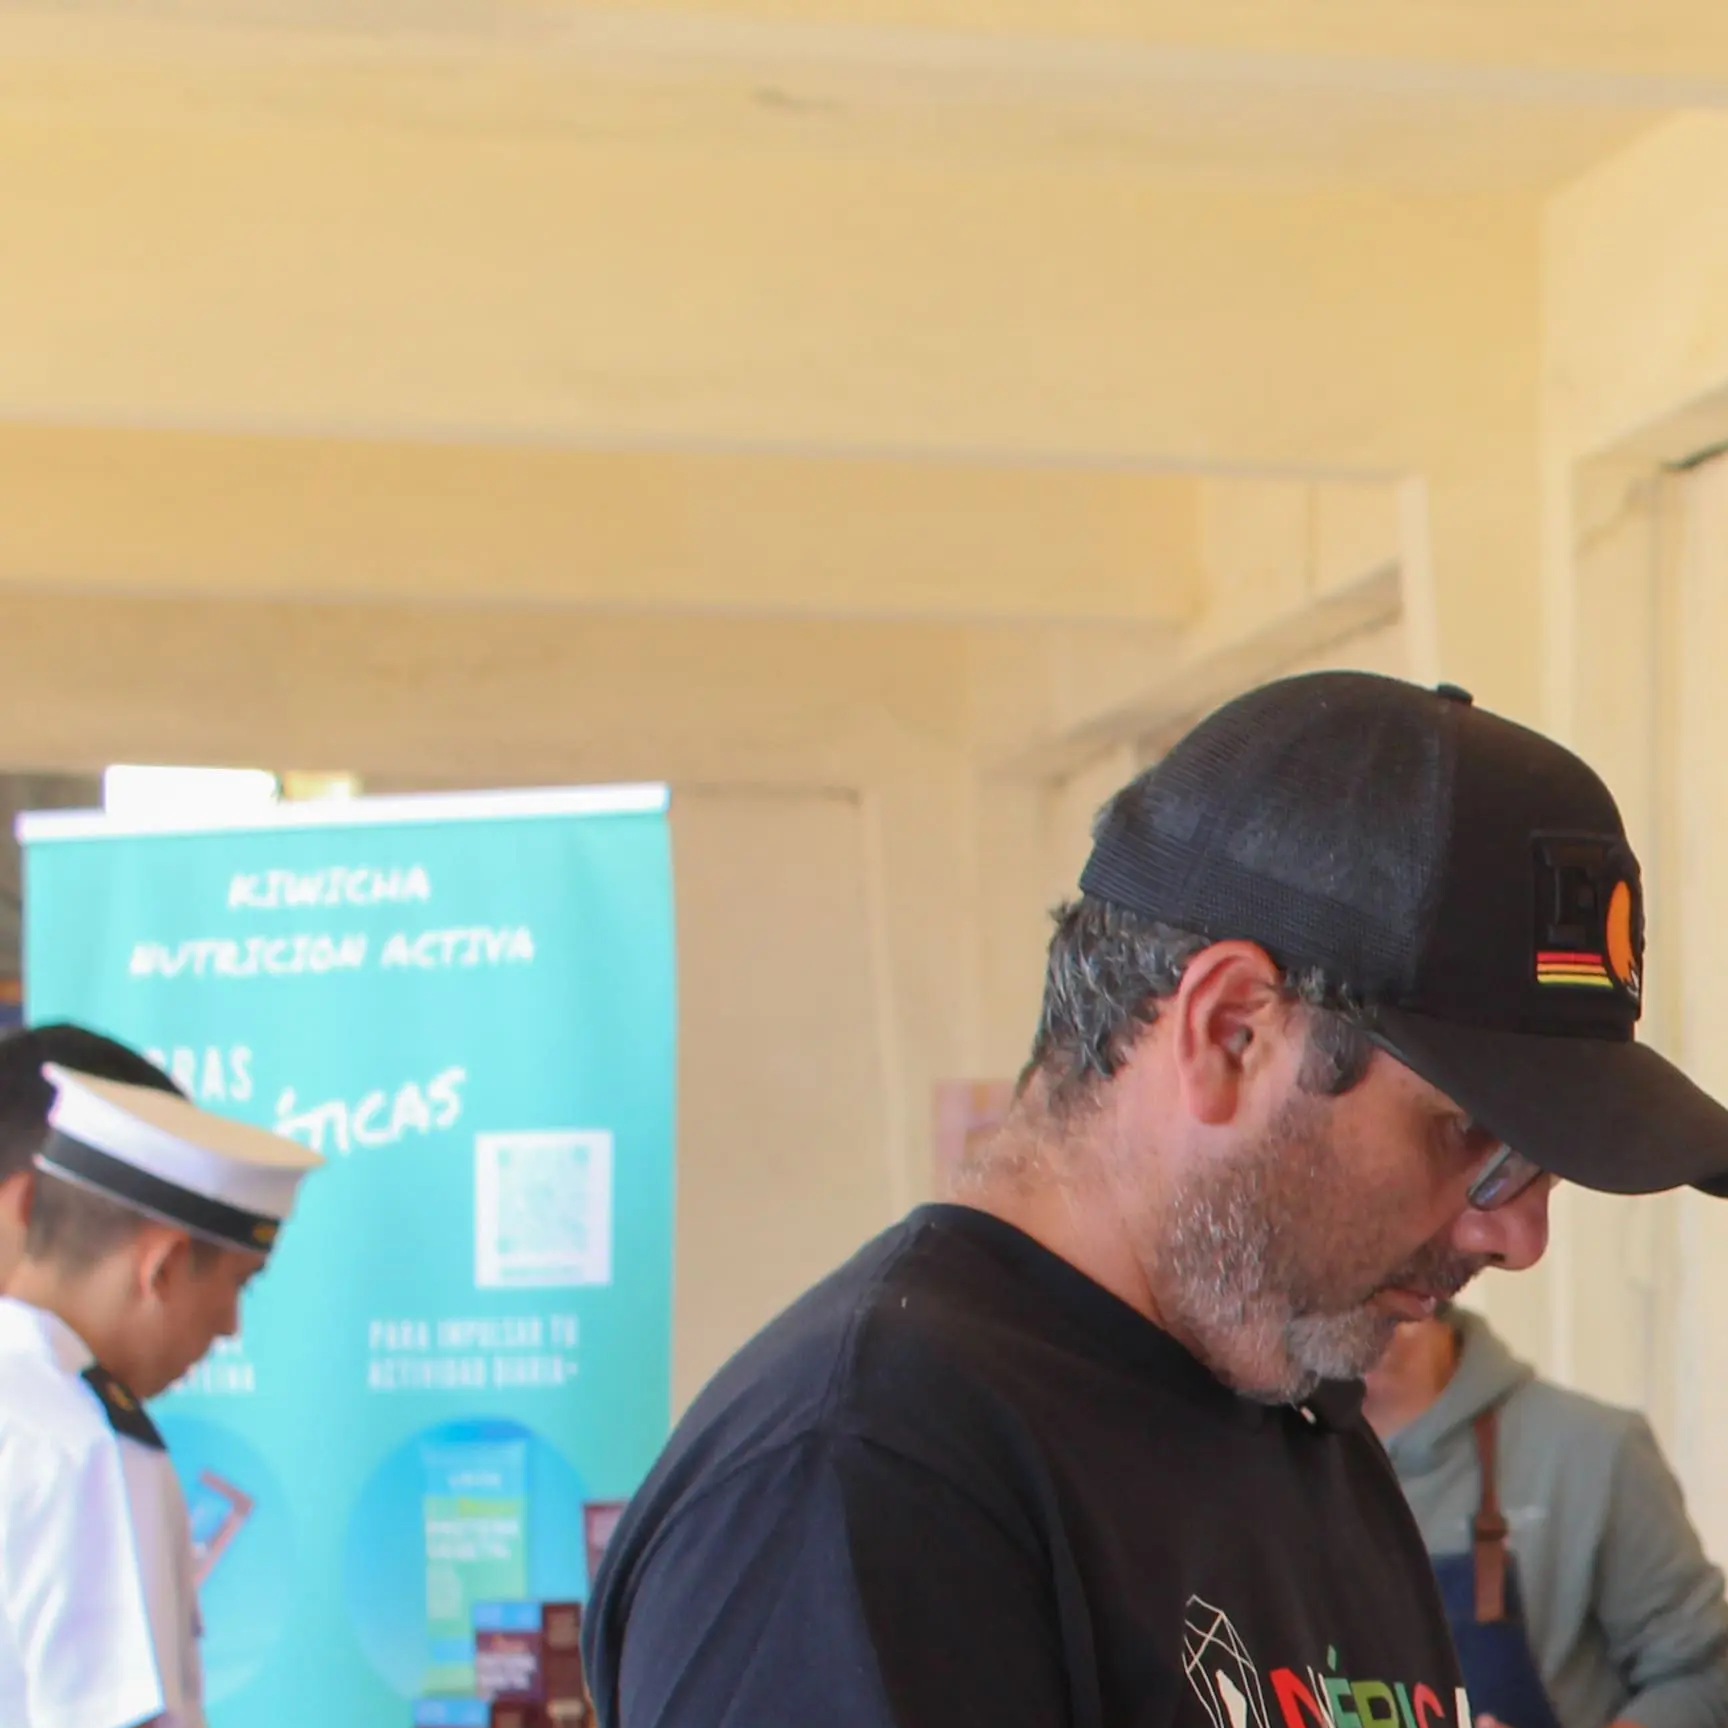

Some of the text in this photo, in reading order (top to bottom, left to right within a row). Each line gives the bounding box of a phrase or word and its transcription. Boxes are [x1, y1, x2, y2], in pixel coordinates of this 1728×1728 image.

[228, 862, 432, 911] KIWICHA
[129, 925, 536, 981] NUTRICION ACTIVA
